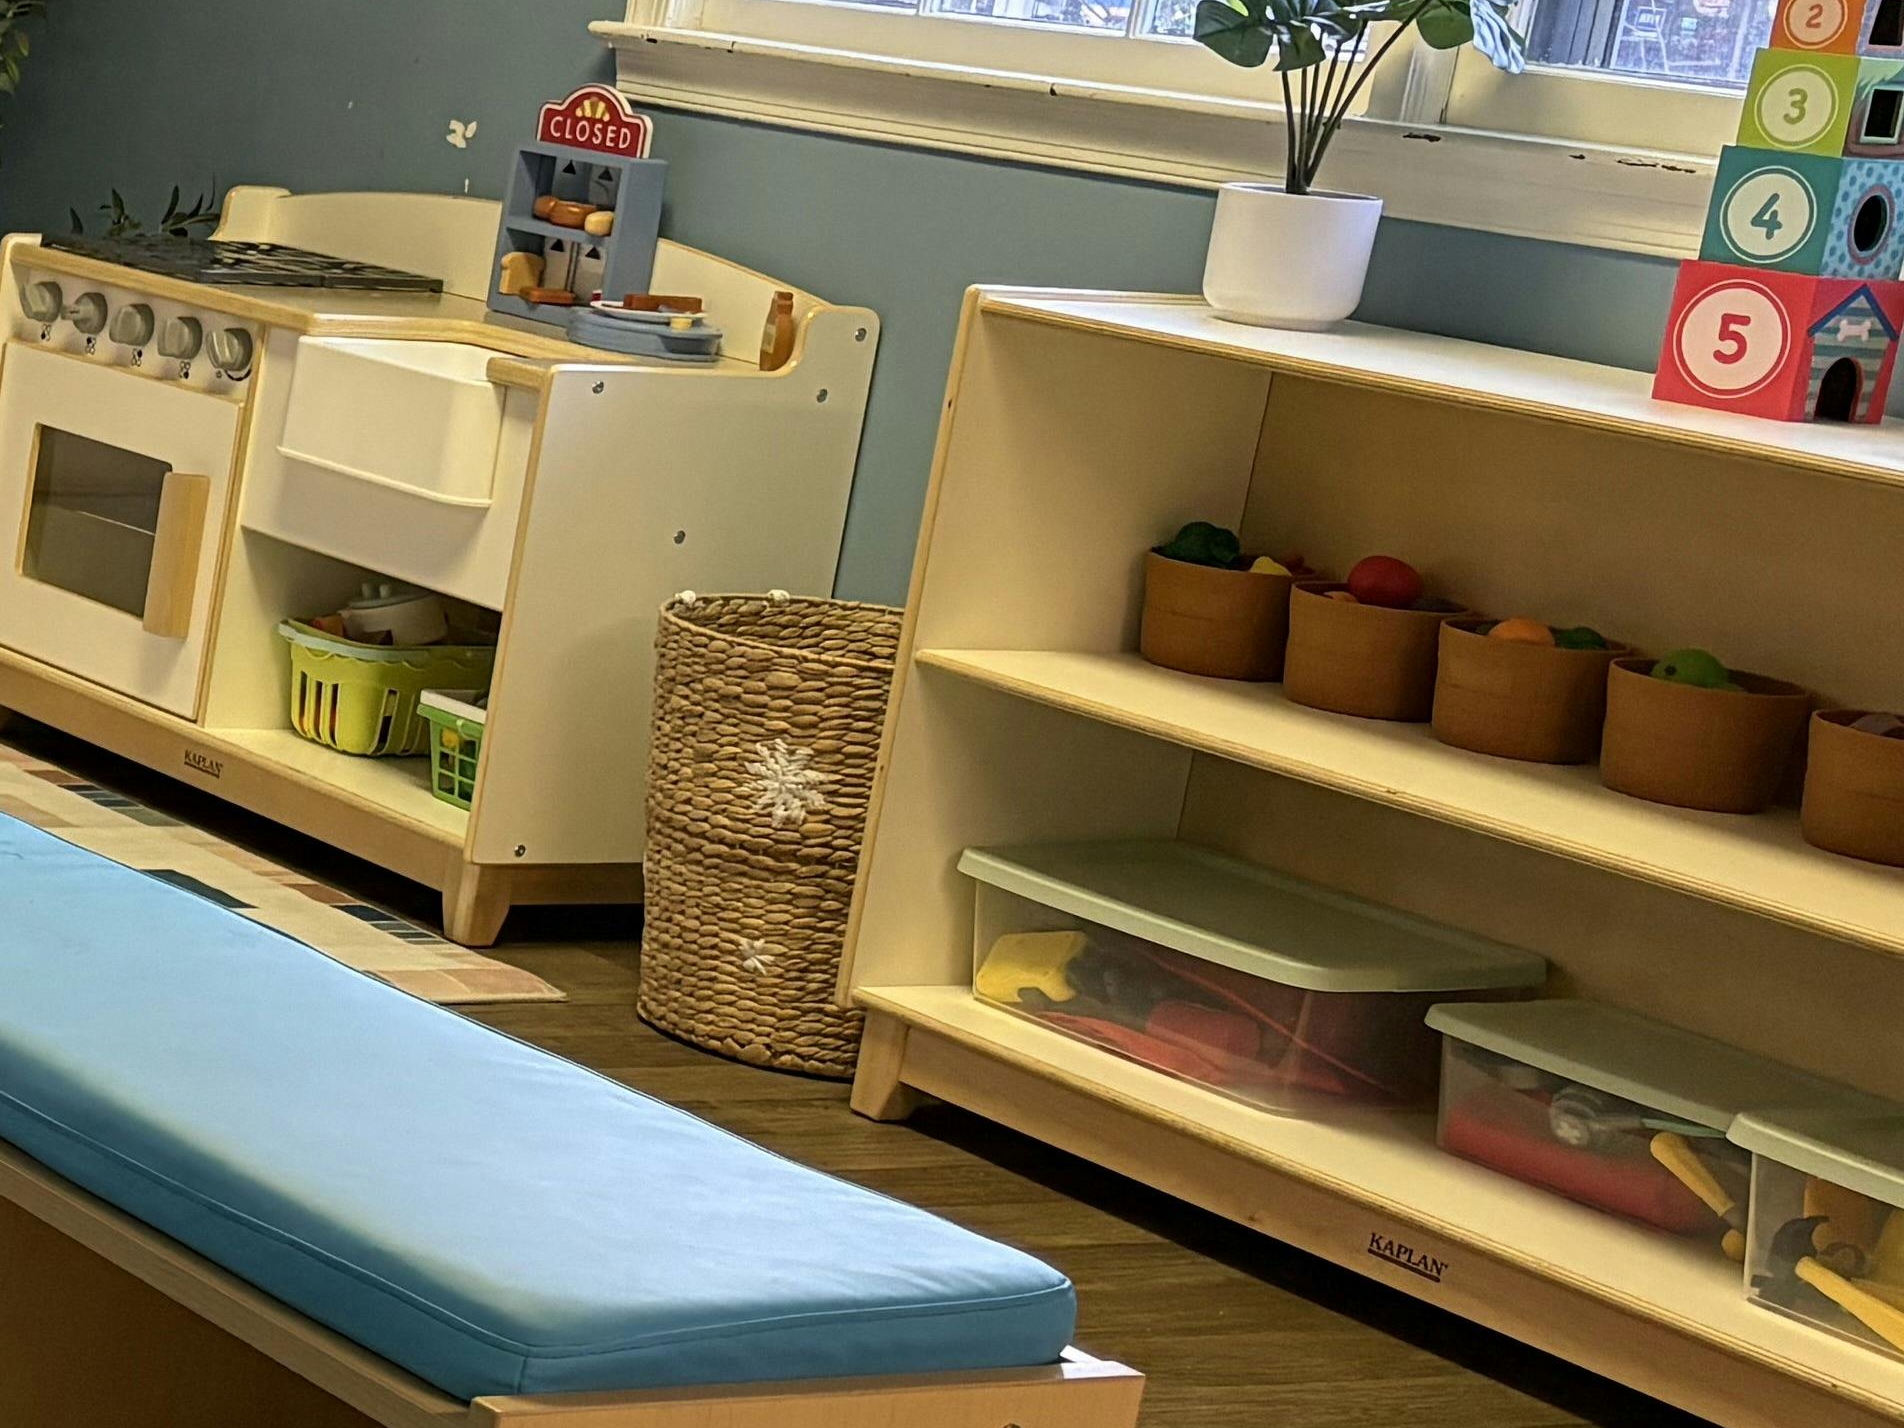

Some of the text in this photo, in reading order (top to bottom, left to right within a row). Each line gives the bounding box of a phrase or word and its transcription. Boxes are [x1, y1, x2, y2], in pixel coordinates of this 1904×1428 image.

[1804, 3, 1824, 30] 2
[1782, 88, 1808, 125] 3
[549, 116, 632, 150] CLOSED
[1750, 193, 1783, 240] 4
[1712, 314, 1752, 365] 5
[1369, 1232, 1447, 1277] KAPLAN
